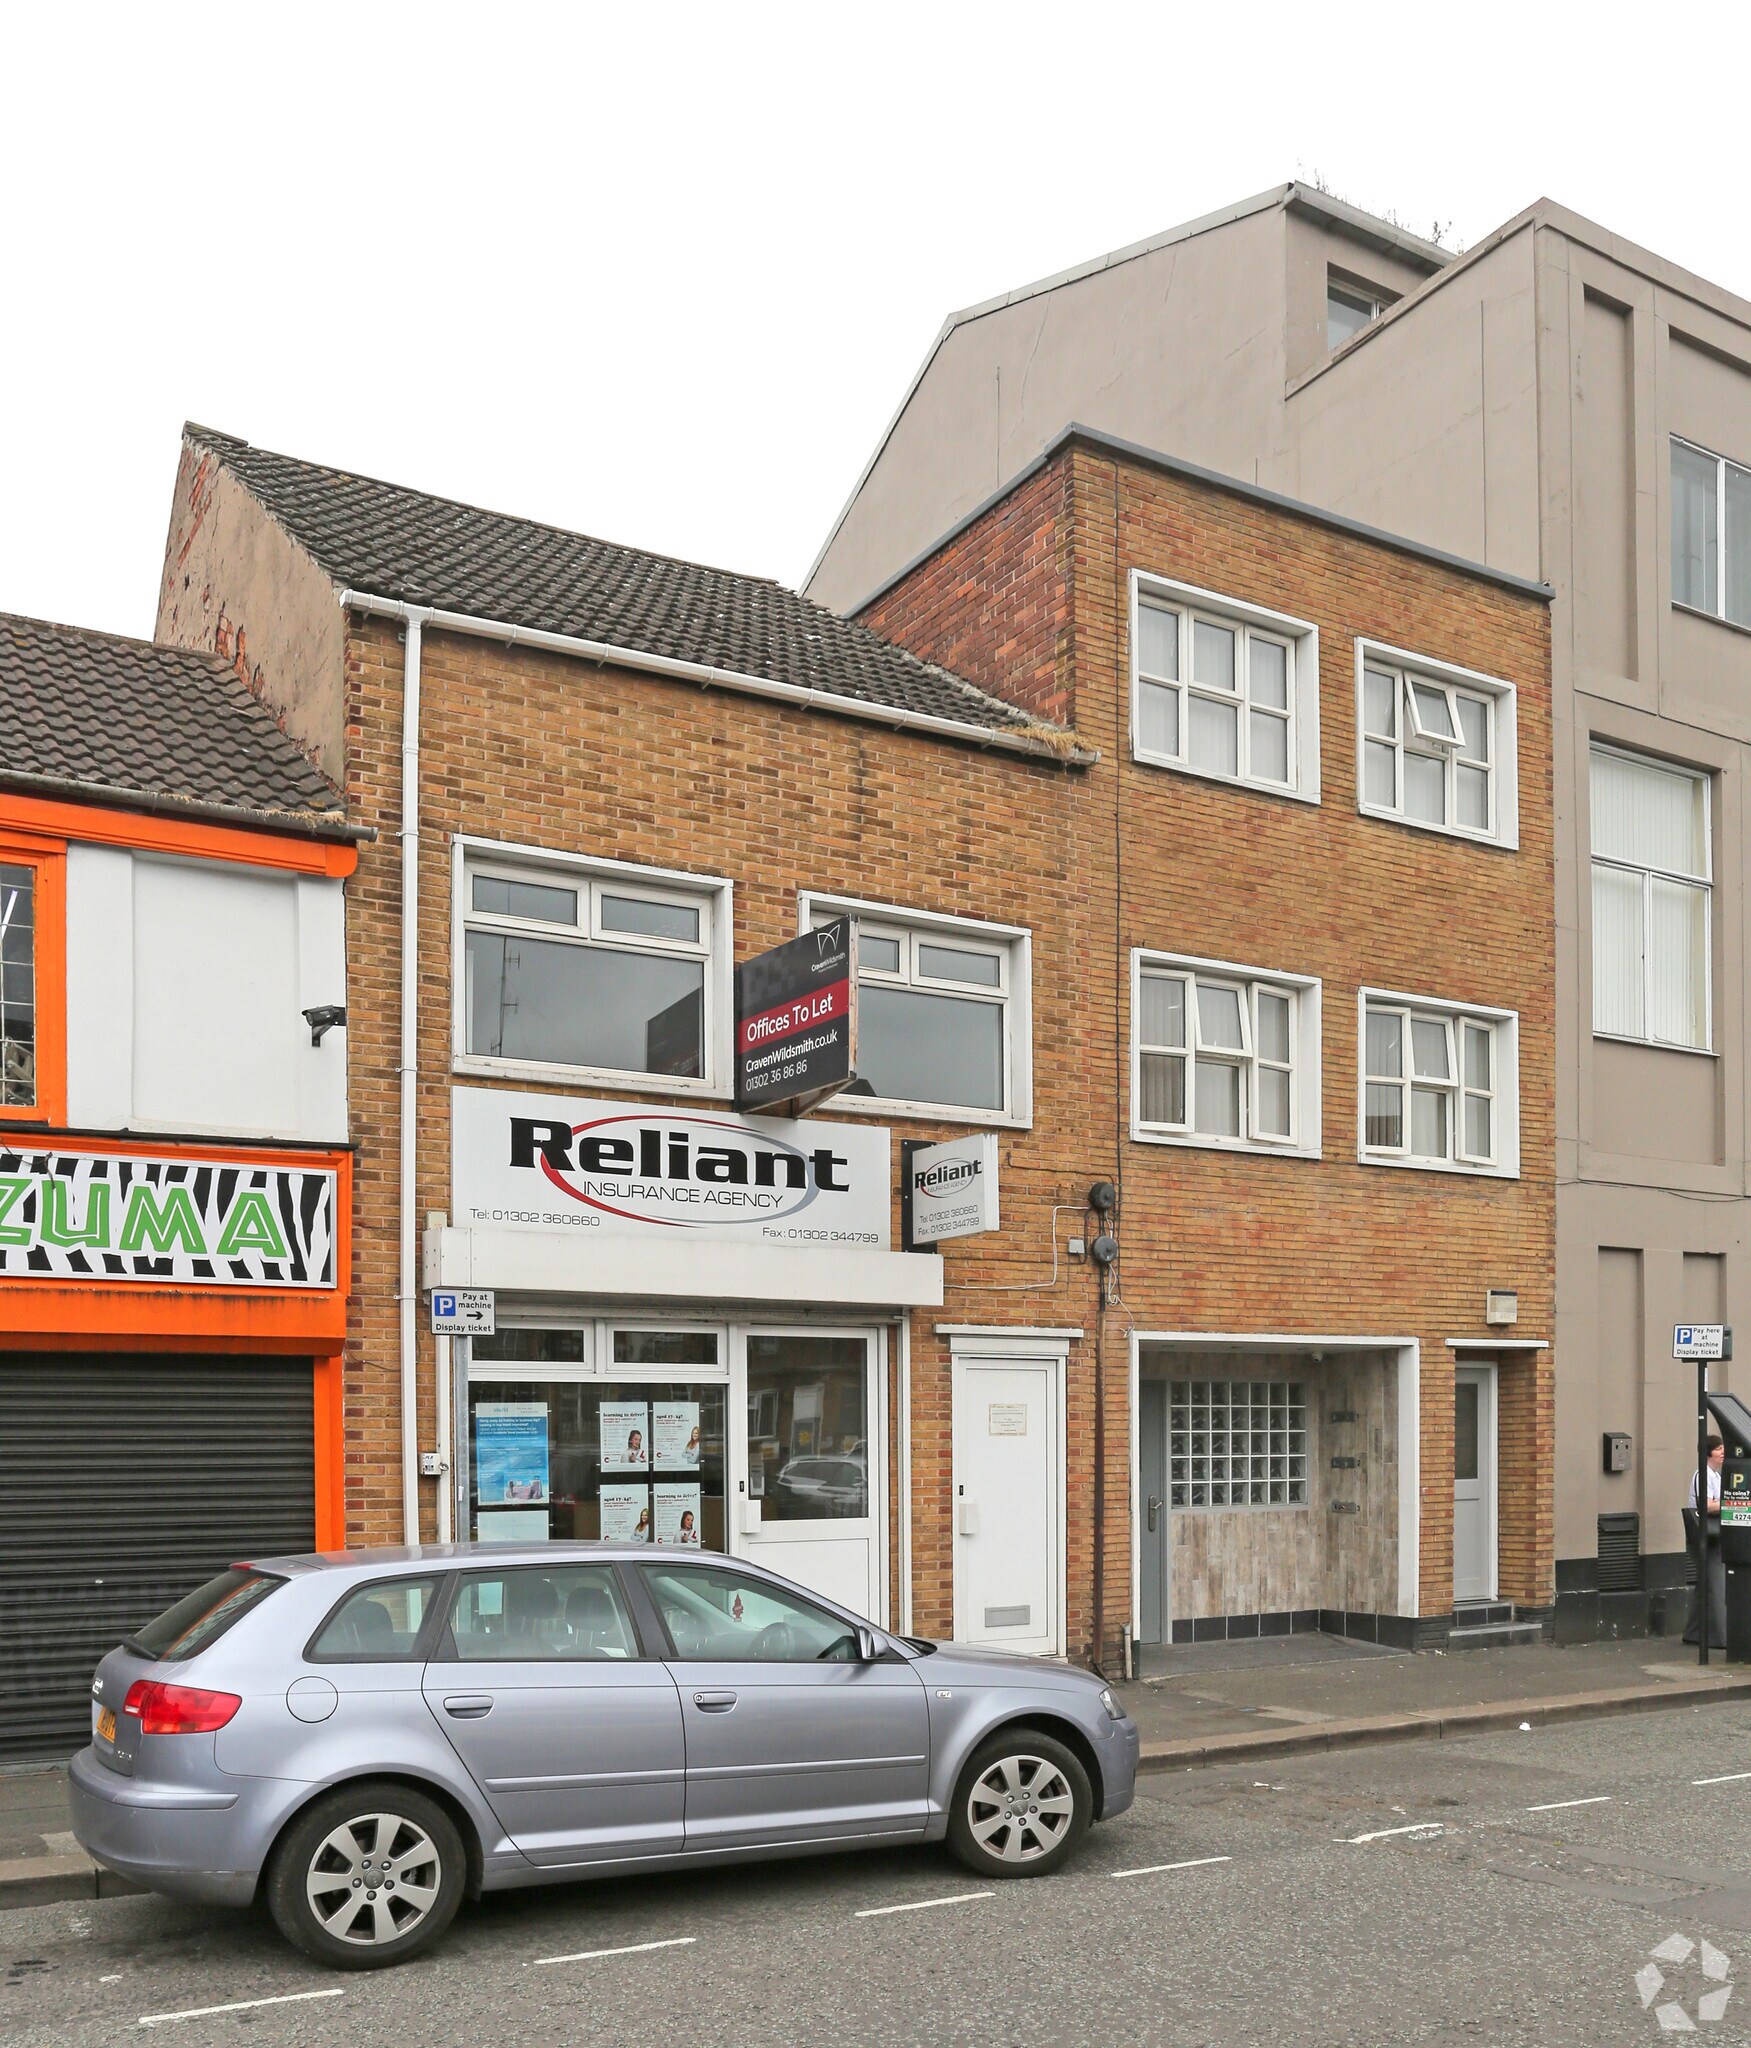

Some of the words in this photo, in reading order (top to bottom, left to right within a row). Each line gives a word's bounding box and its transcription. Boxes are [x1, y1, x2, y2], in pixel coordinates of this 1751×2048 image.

[747, 1014, 790, 1042] Offices
[792, 1004, 810, 1026] To
[812, 993, 833, 1018] Let
[746, 1028, 838, 1073] CravenWildsmith.co.uk
[745, 1072, 769, 1092] 01302
[770, 1068, 781, 1083] 36
[783, 1063, 795, 1078] 86
[796, 1059, 808, 1074] 86
[508, 1116, 850, 1192] Reliant
[914, 1159, 983, 1190] Reliant
[583, 1181, 701, 1203] INSURANCE
[704, 1190, 785, 1209] AGENCY
[470, 1208, 490, 1221] Tel:
[493, 1209, 540, 1223] 01302
[542, 1213, 600, 1227] 360660
[928, 1210, 951, 1222] 01302
[930, 1222, 952, 1234] 01302
[952, 1216, 980, 1230] 344799
[762, 1226, 786, 1239] Fax:
[788, 1228, 830, 1242] 01302
[830, 1231, 879, 1244] 344799
[439, 1297, 453, 1314] P
[462, 1292, 477, 1301] Pay
[436, 1323, 465, 1332] Display
[1679, 1329, 1691, 1344] P
[1733, 1473, 1744, 1488] P
